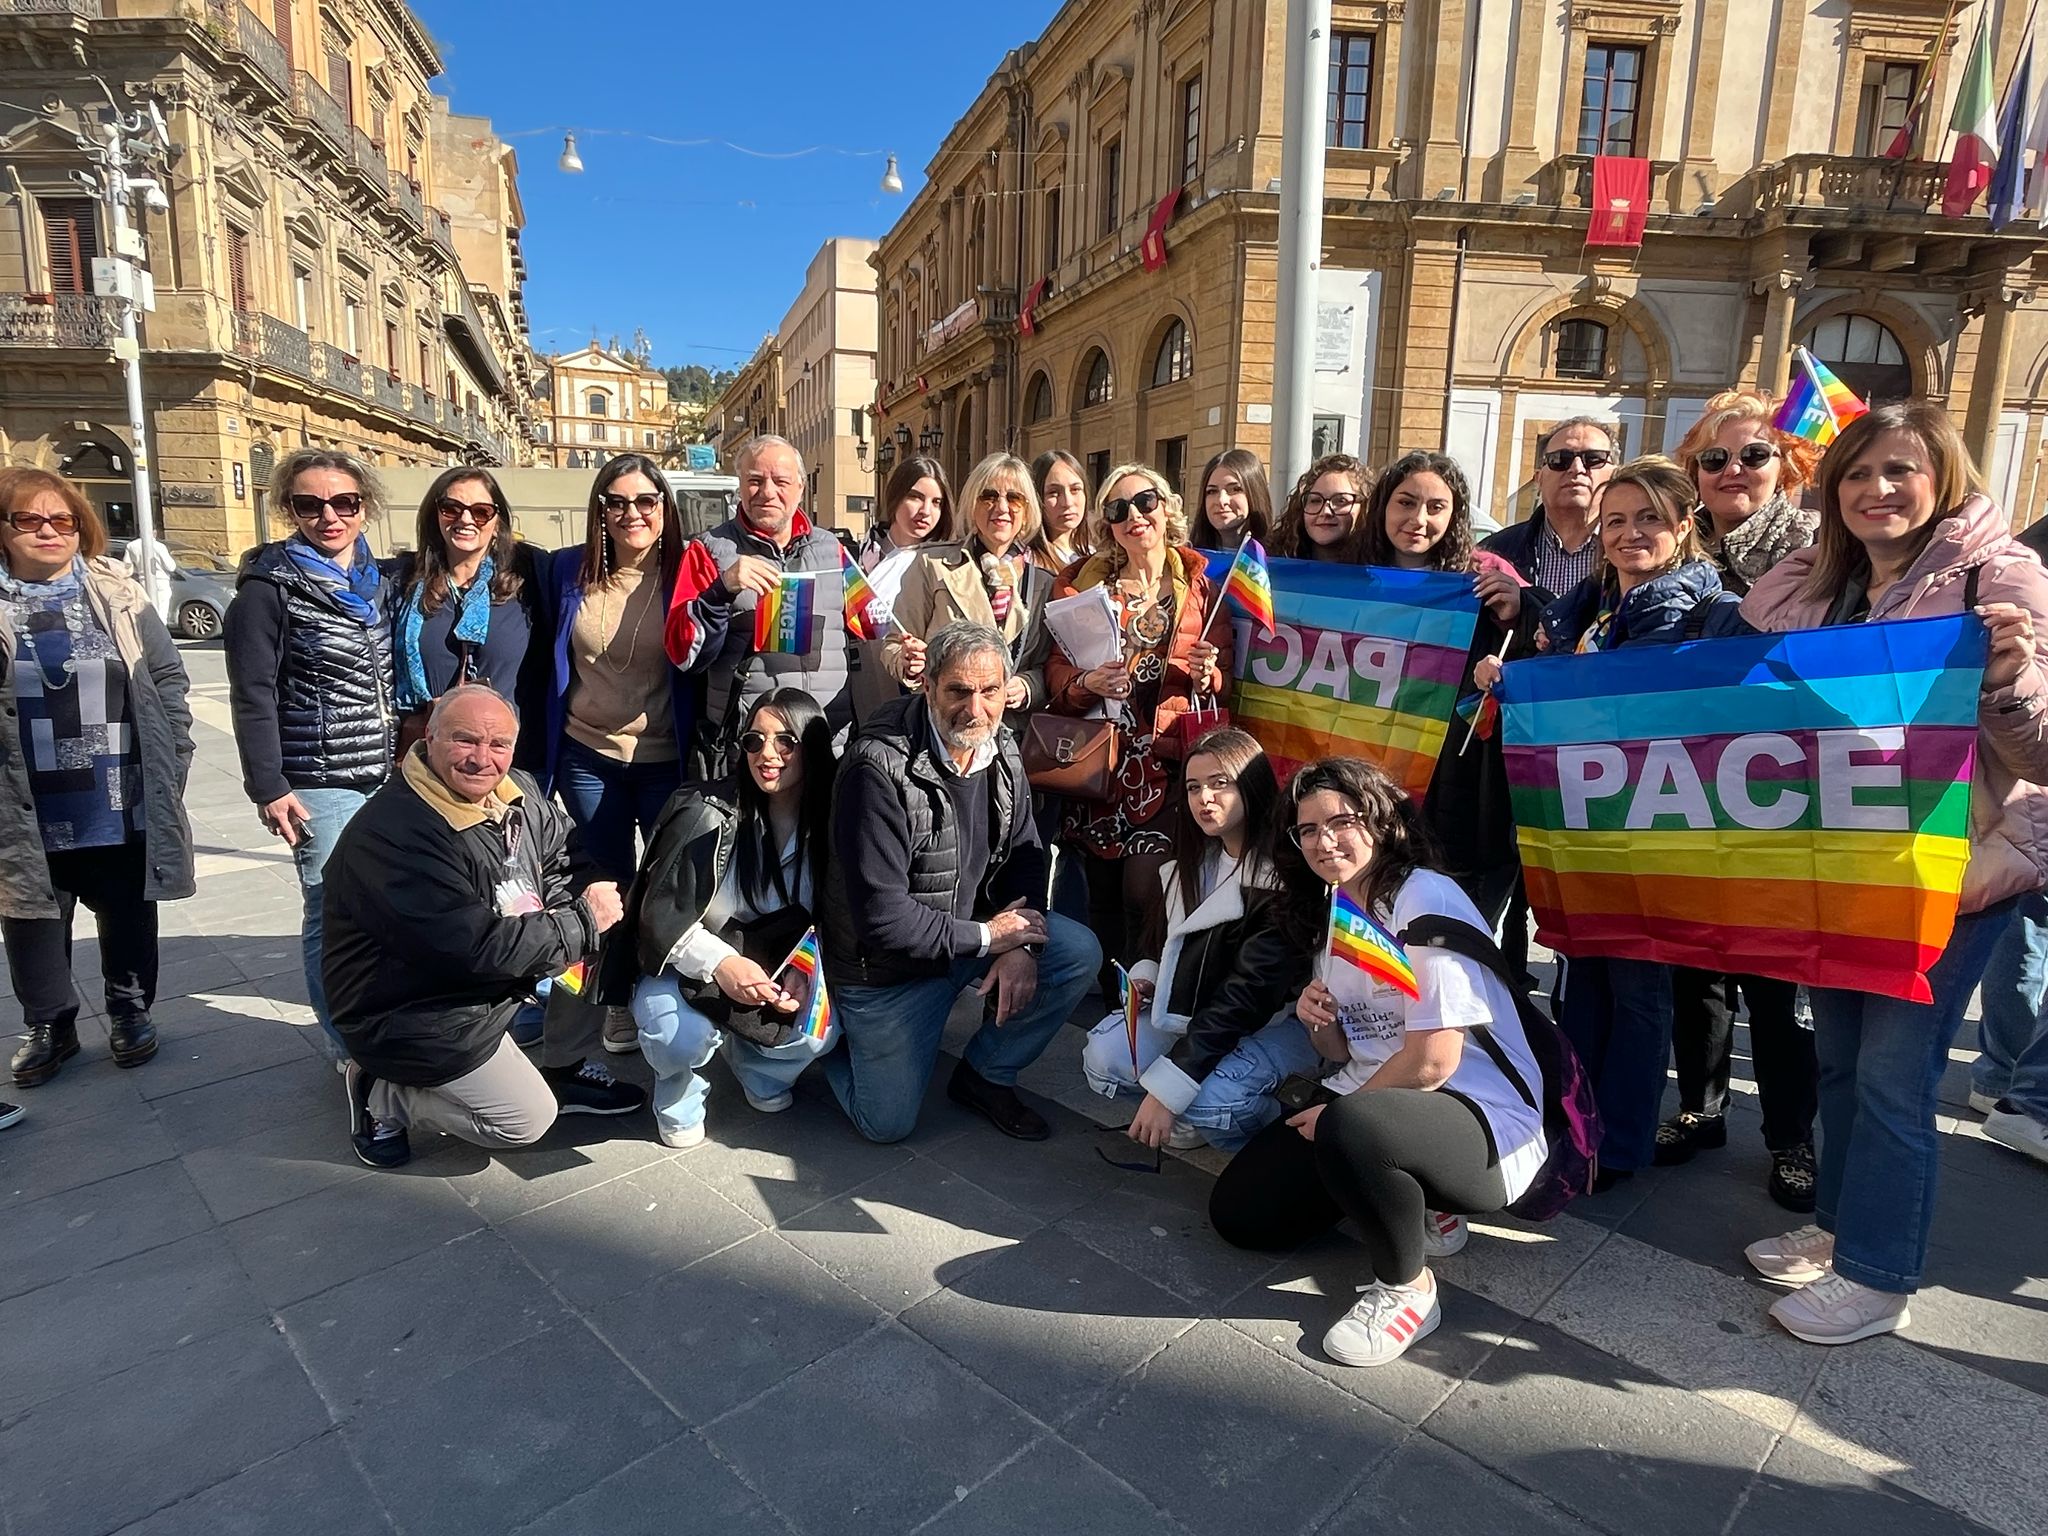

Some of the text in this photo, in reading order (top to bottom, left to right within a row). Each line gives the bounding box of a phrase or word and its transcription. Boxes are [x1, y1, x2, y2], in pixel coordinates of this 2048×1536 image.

[780, 590, 798, 640] PACE
[1556, 726, 1910, 831] PACE
[1349, 914, 1402, 964] PACE
